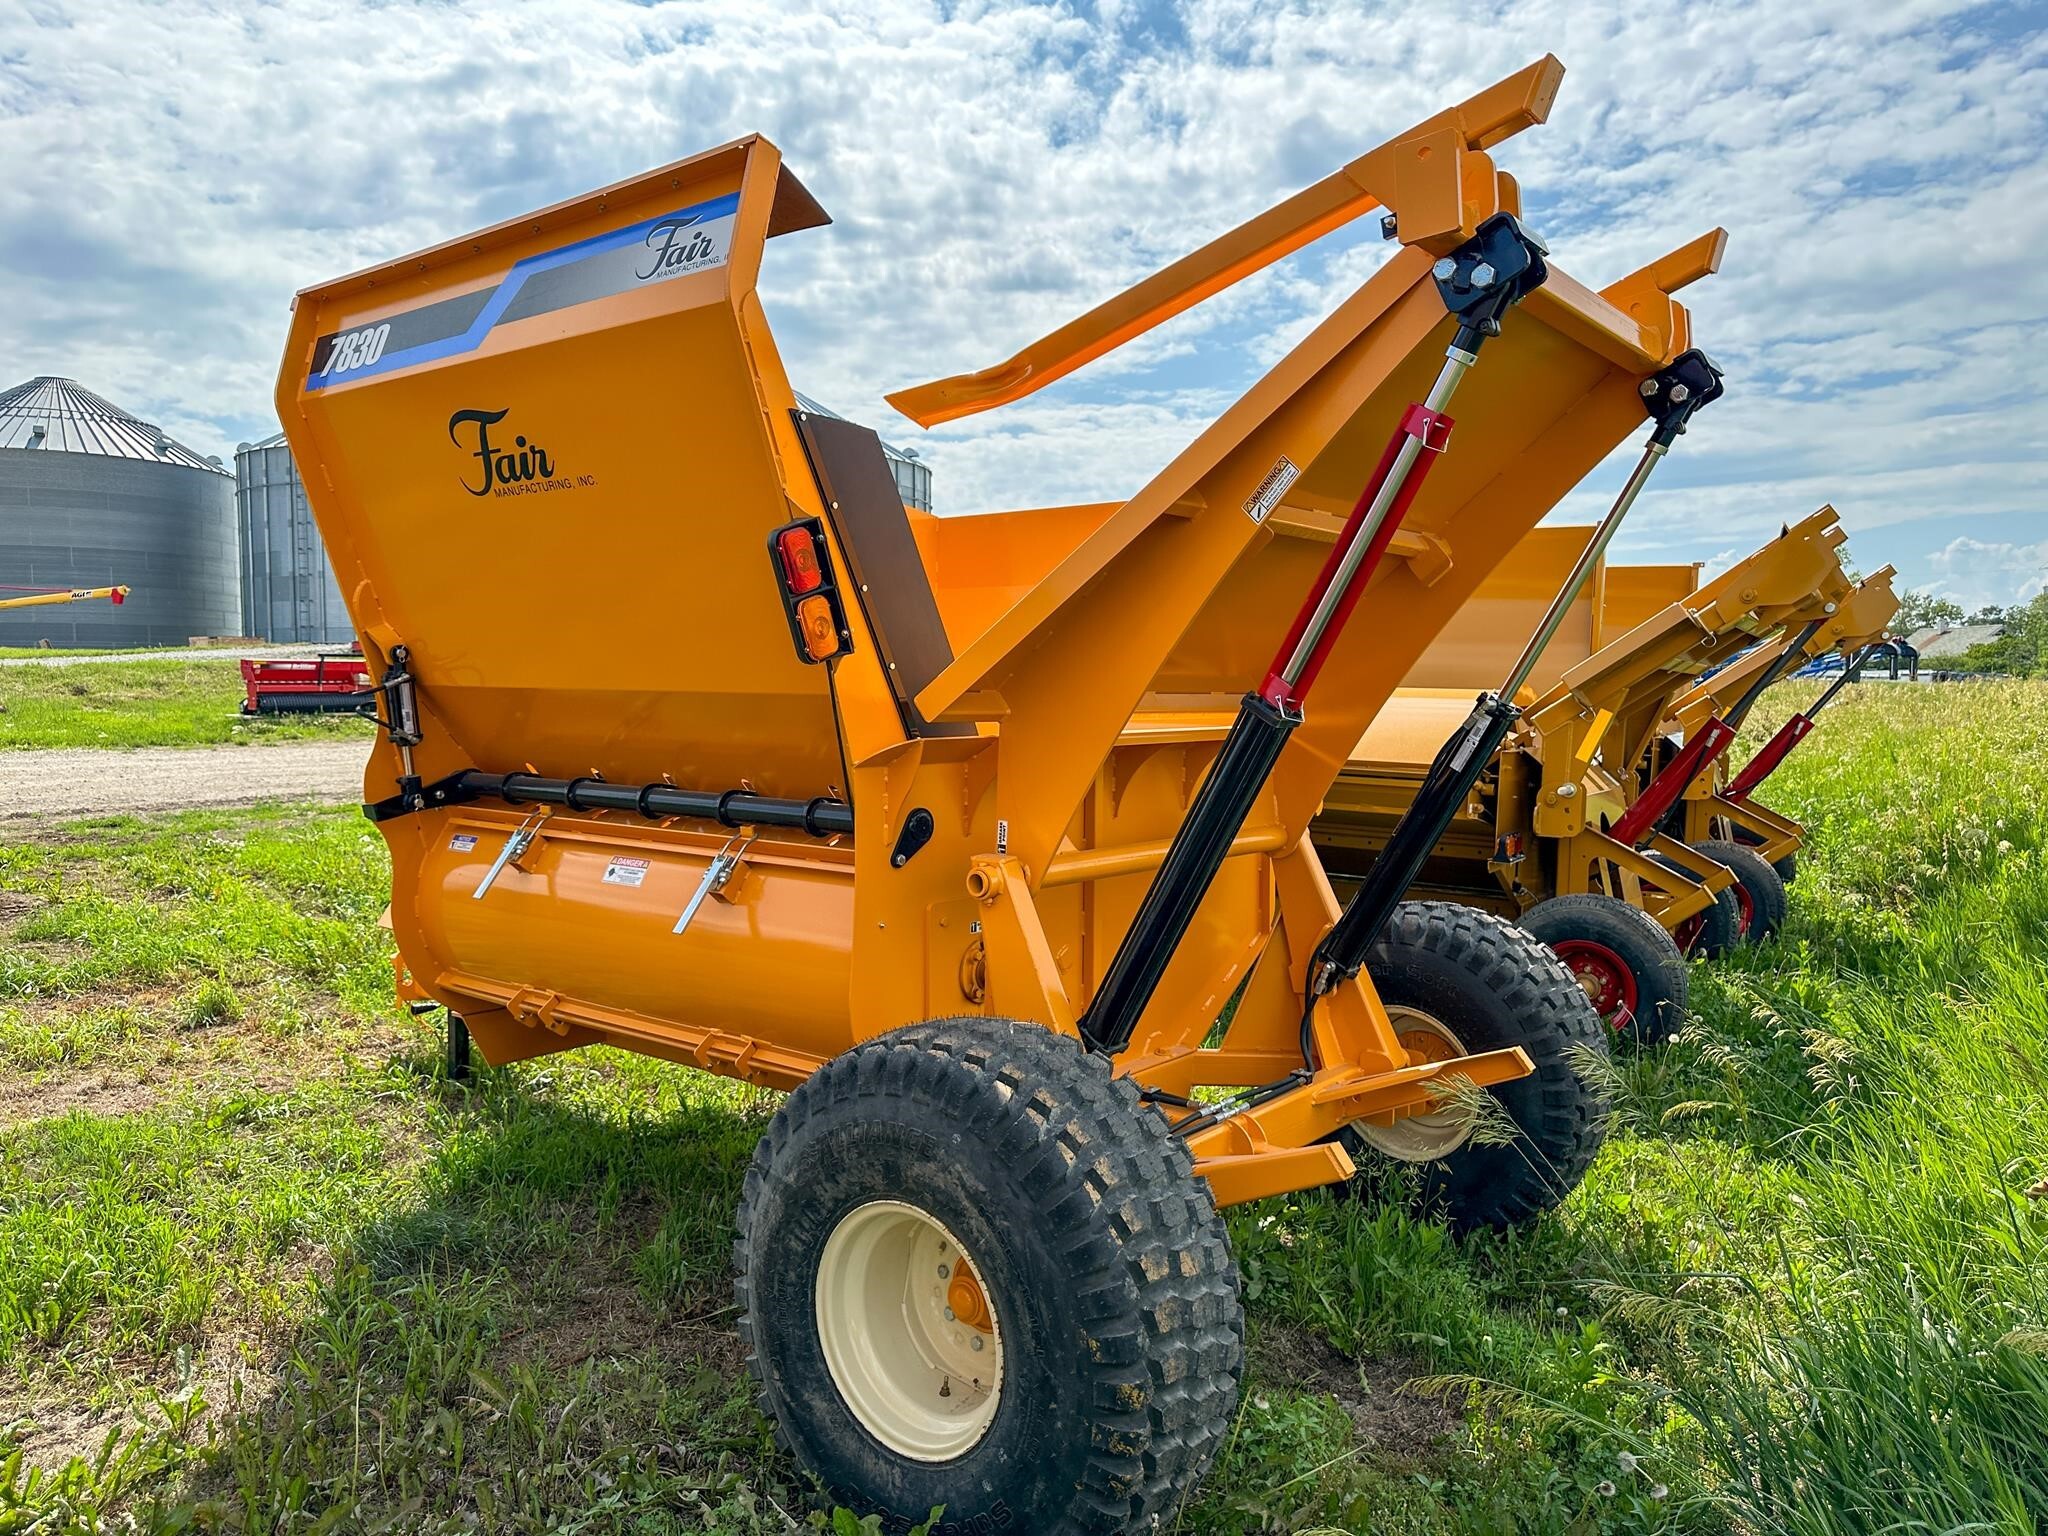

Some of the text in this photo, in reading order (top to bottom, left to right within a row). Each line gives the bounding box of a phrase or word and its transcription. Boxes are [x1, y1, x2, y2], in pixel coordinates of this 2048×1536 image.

[634, 213, 715, 280] Fair
[320, 323, 391, 378] 7830
[448, 407, 555, 497] Fair
[493, 474, 599, 499] MANUFACTURING, INC.
[1250, 466, 1281, 504] WARNING
[616, 857, 645, 868] DANGER
